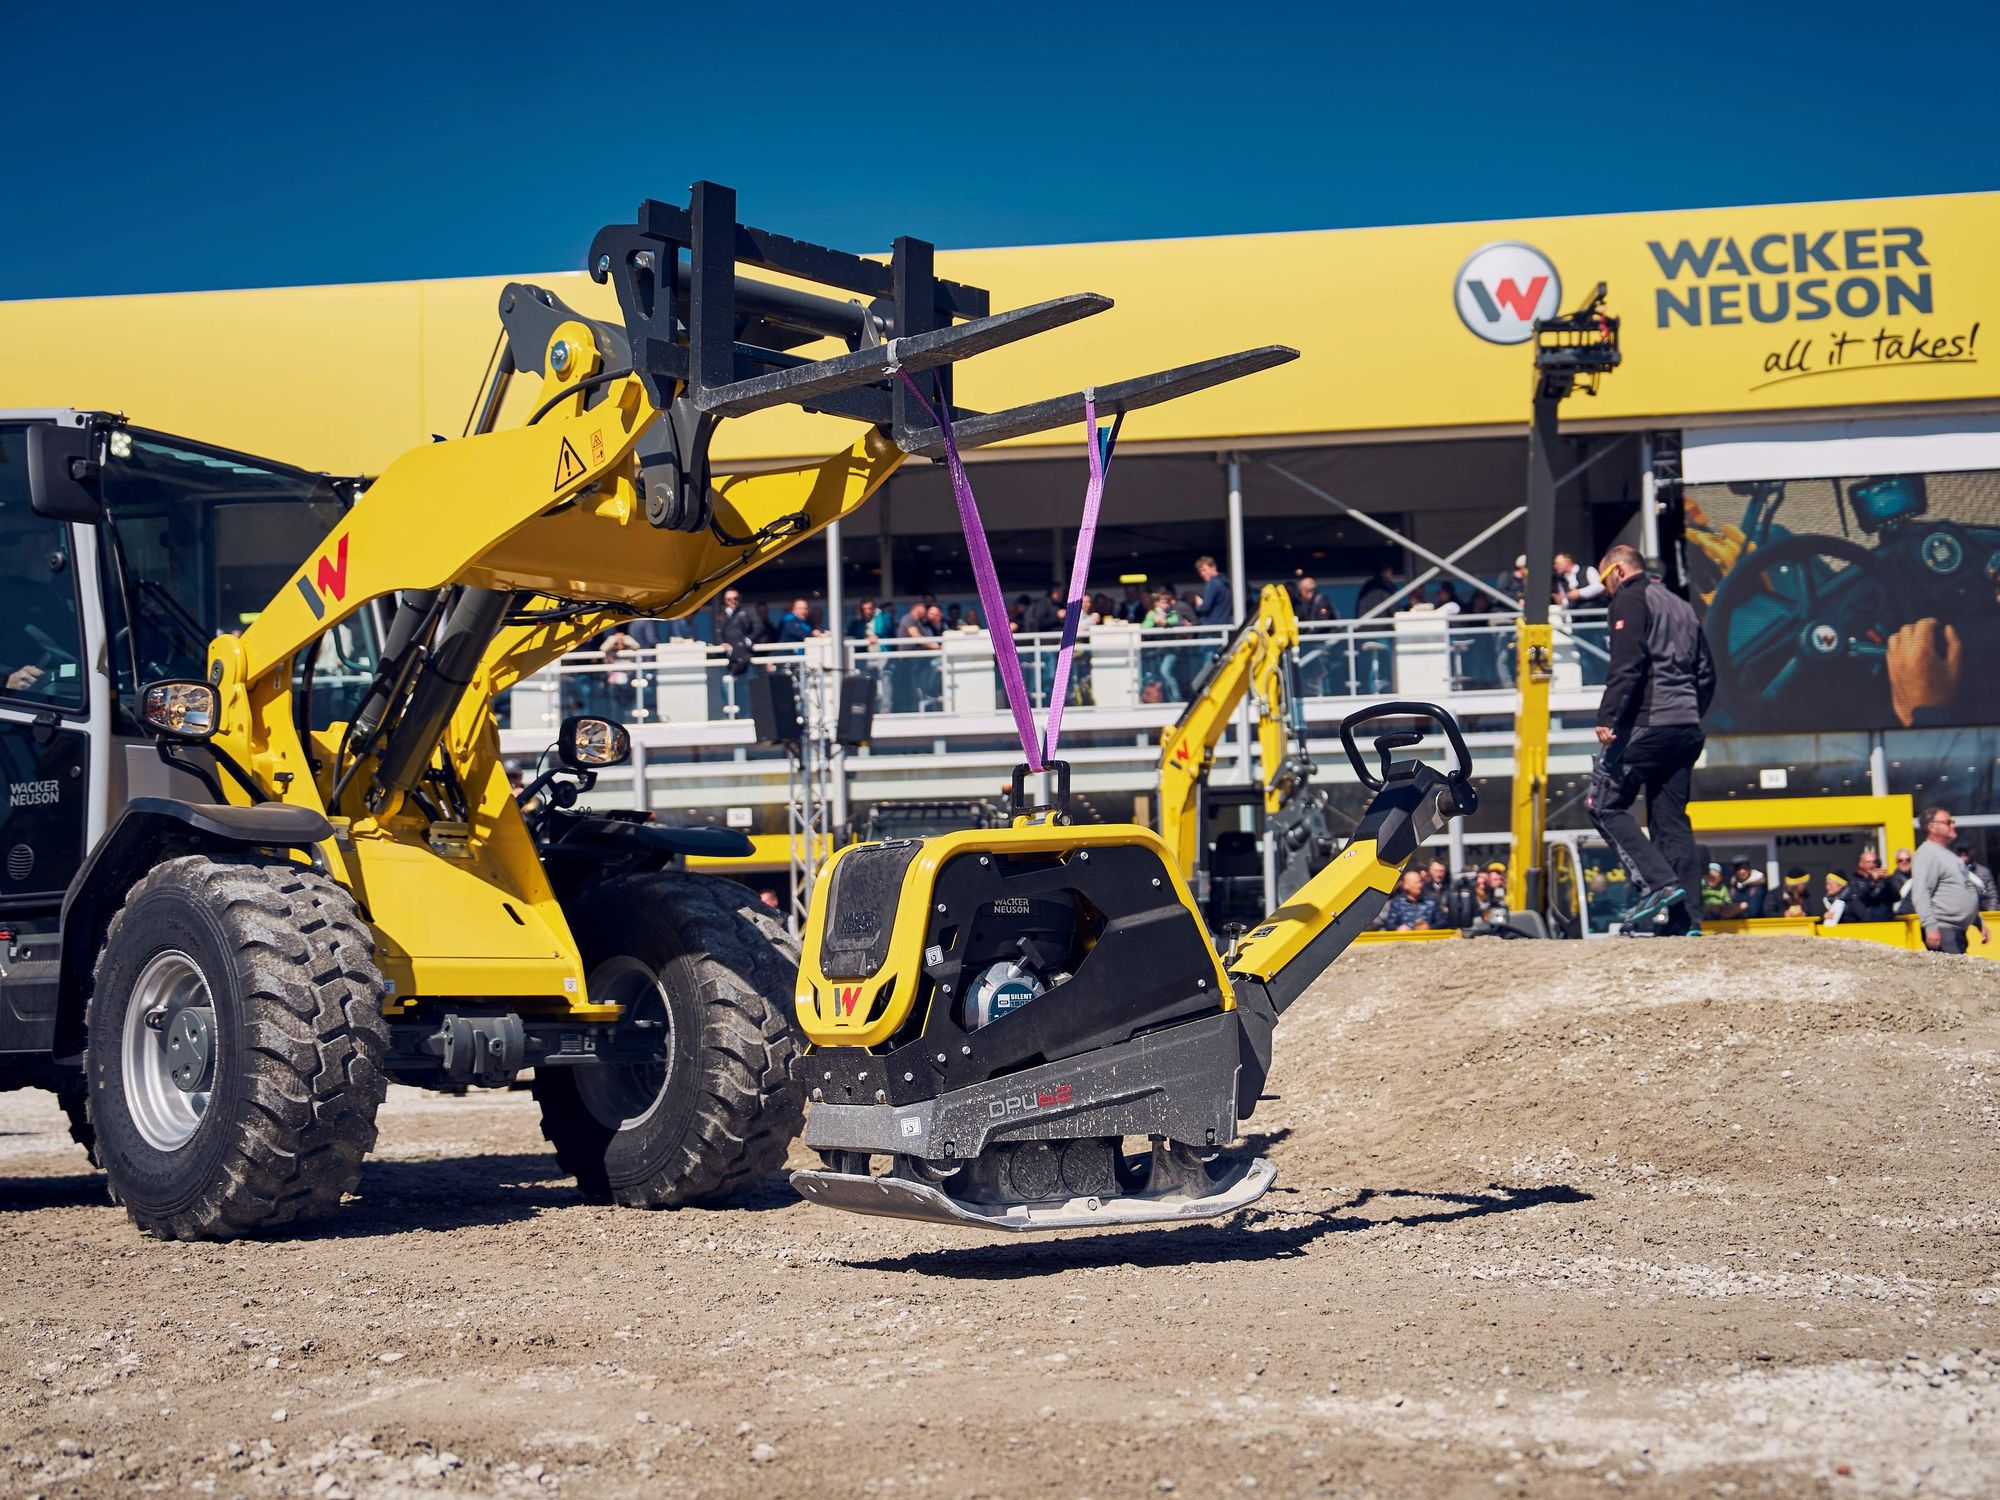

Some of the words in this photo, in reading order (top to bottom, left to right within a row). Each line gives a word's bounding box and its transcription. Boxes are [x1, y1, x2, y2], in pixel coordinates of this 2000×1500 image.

[1646, 226, 1931, 280] WACKER
[1655, 273, 1934, 329] NEUSON
[1763, 339, 1813, 373] all
[1828, 331, 1866, 366] it
[1872, 321, 1981, 362] takes!
[10, 779, 60, 795] WACKER
[10, 791, 60, 807] NEUSON
[993, 905, 1030, 914] NEUSON
[994, 898, 1029, 906] WACKER
